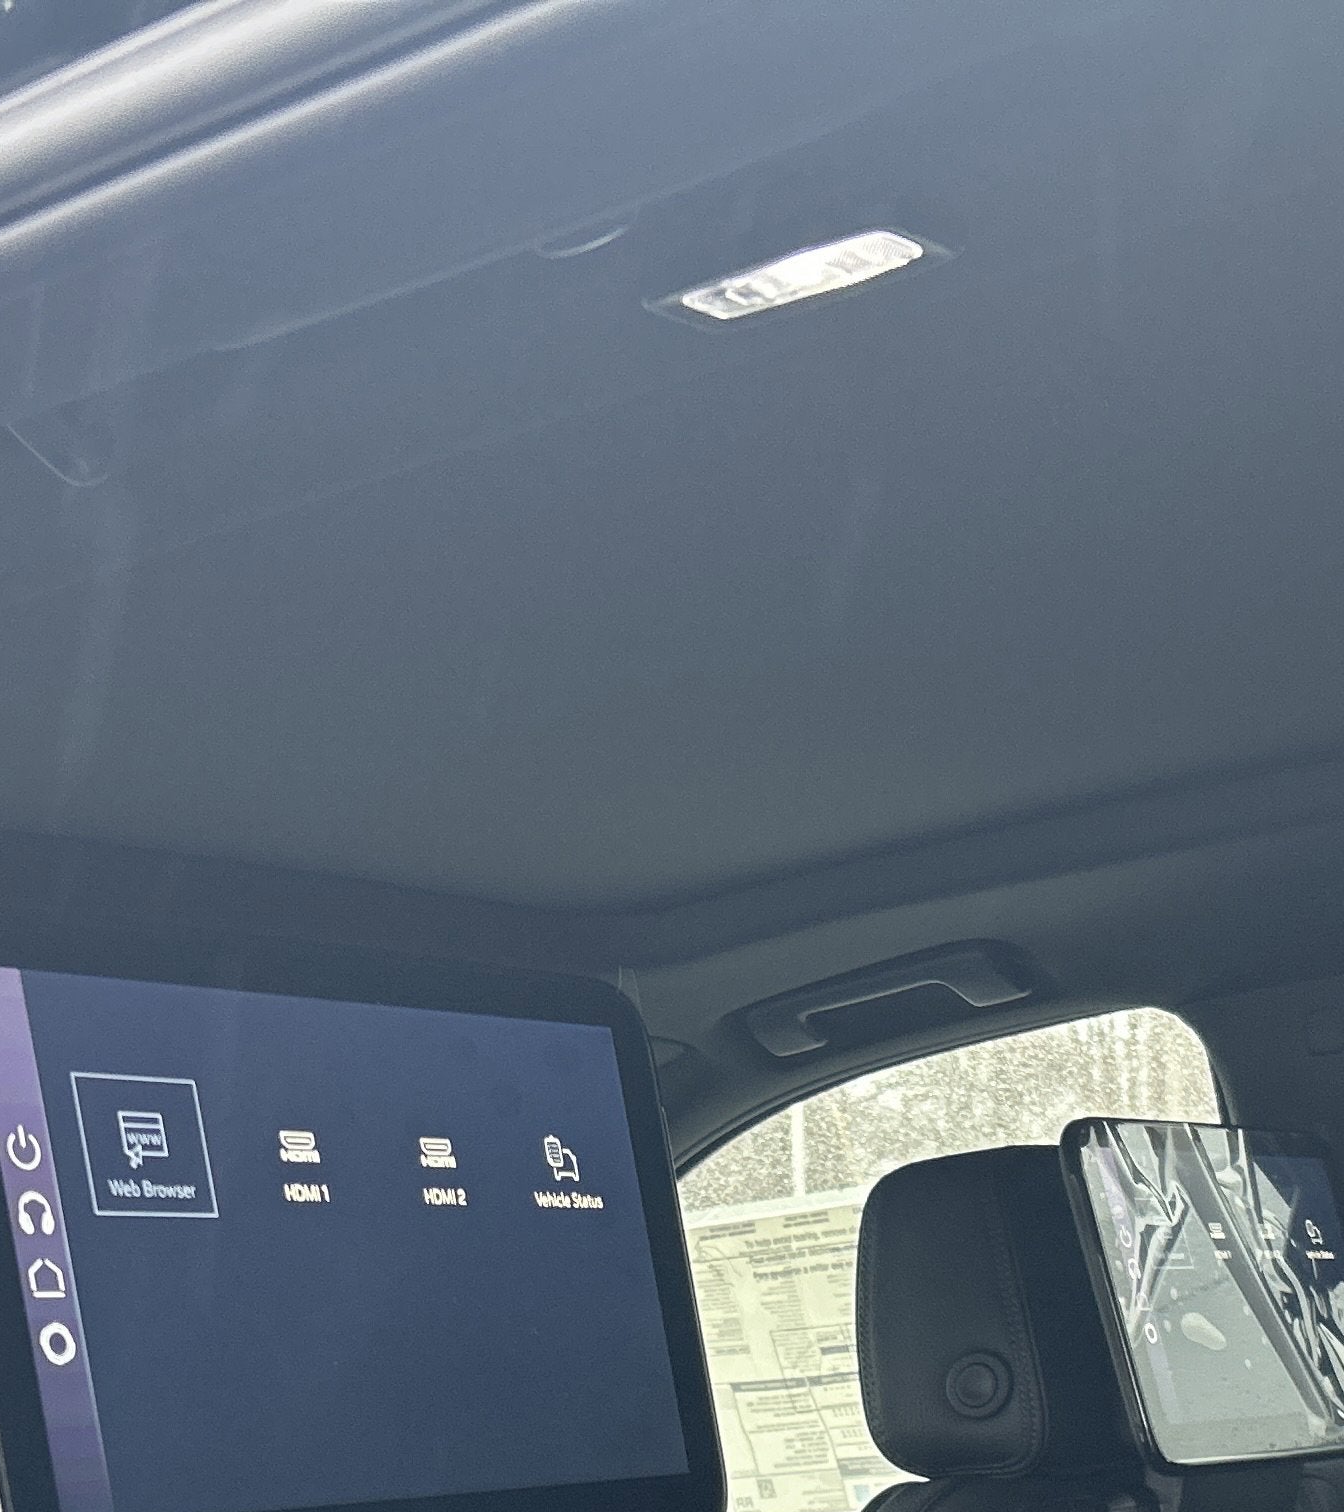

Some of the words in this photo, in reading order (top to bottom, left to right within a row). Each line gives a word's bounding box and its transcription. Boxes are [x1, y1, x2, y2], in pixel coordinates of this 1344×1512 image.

[107, 1178, 141, 1198] Web
[142, 1179, 197, 1199] Browser
[283, 1183, 322, 1203] HDMI
[321, 1184, 331, 1203] 1
[423, 1187, 457, 1206] HDMI
[457, 1187, 468, 1206] 2
[533, 1190, 572, 1208] Vehicle
[571, 1191, 604, 1209] Status
